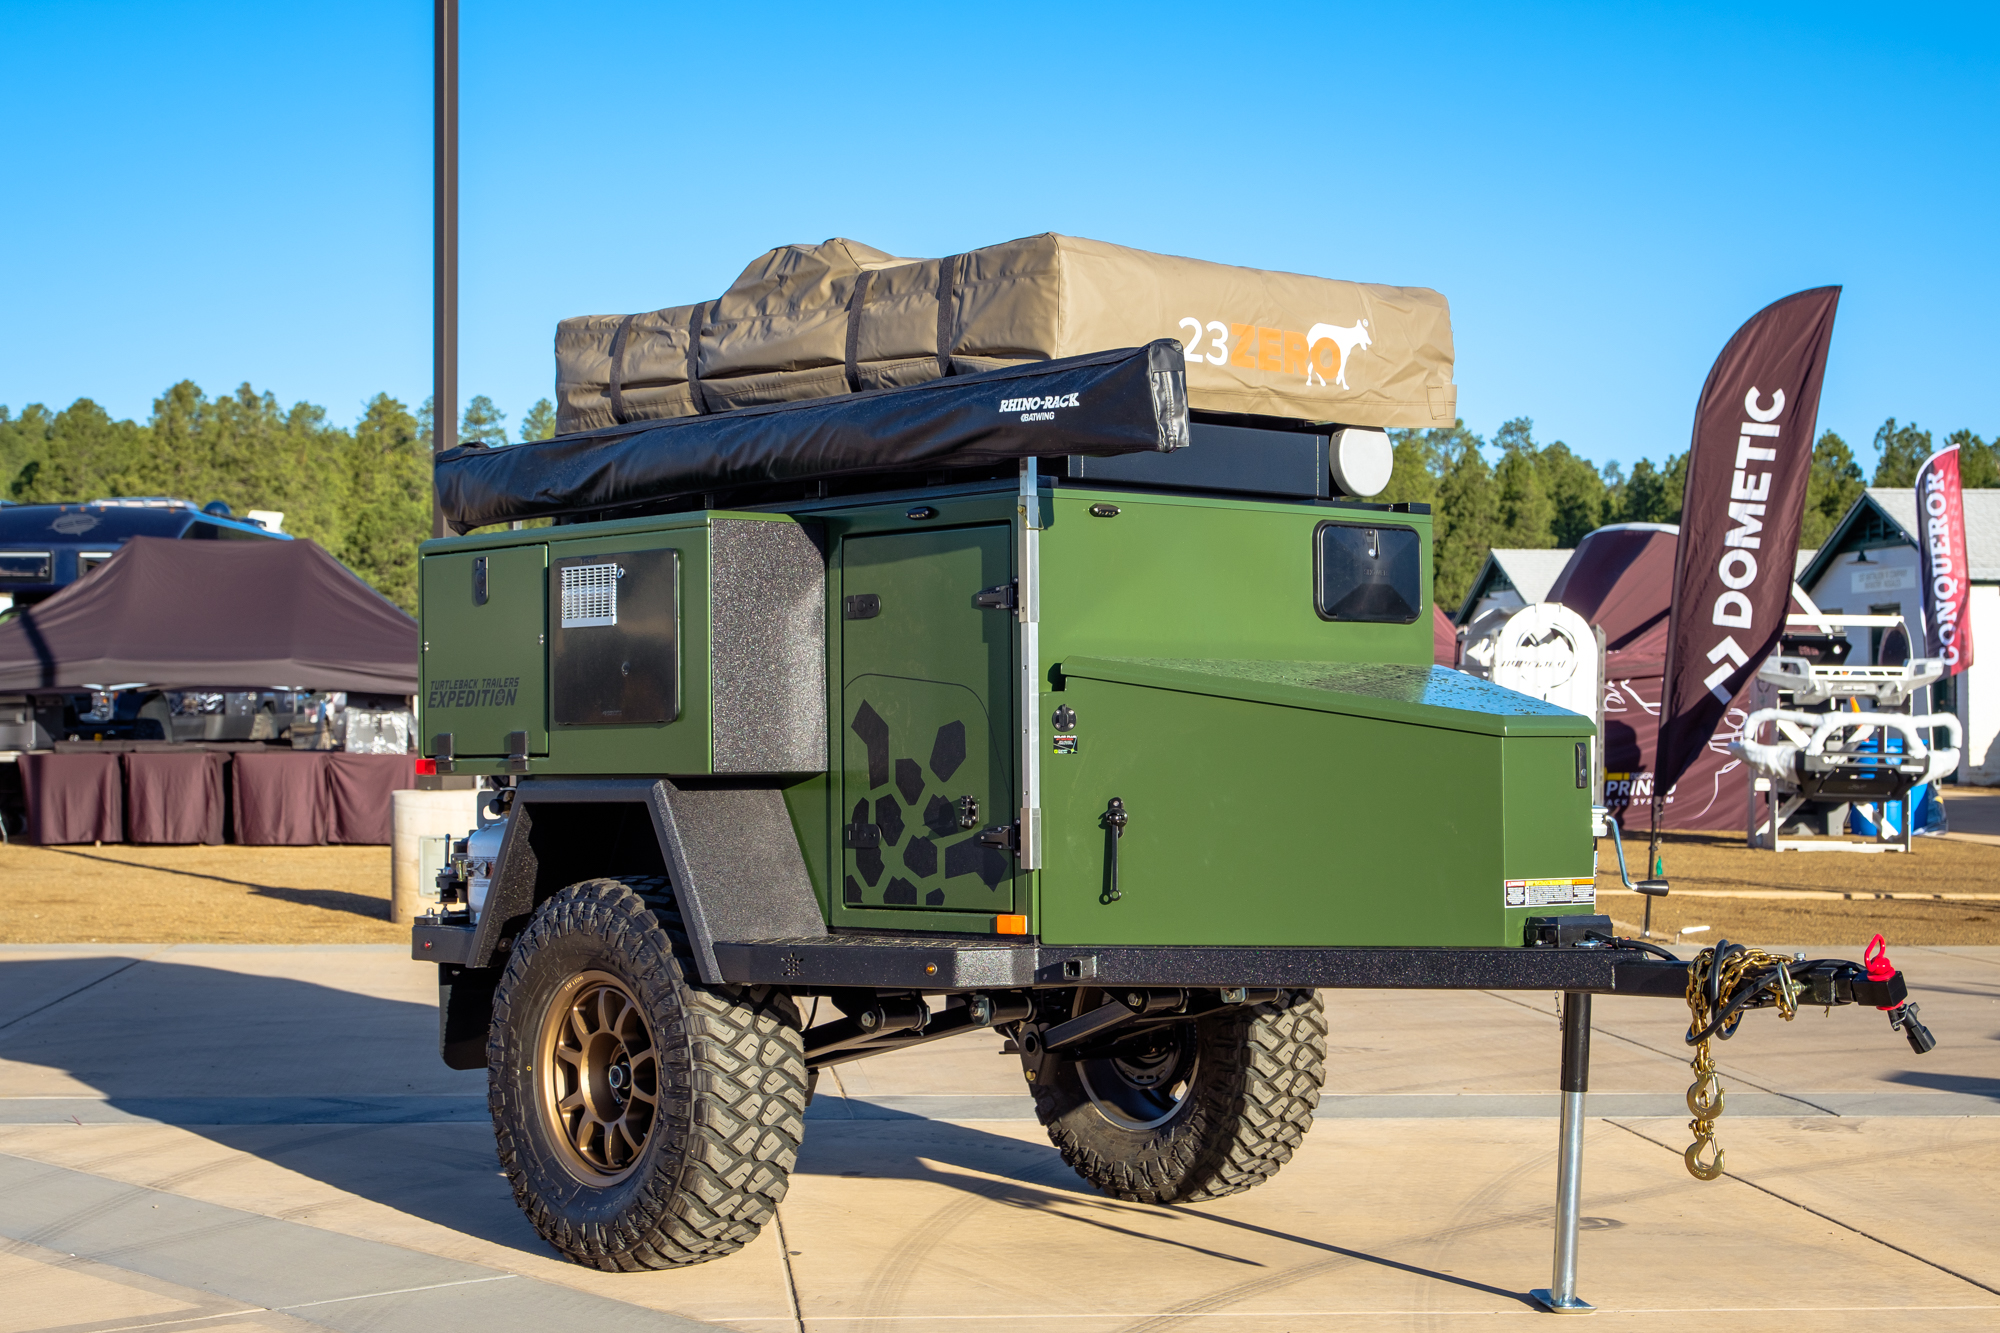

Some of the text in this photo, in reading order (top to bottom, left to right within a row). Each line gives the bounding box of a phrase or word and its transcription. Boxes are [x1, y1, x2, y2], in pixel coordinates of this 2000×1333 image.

[1178, 316, 1342, 380] 23ZERO
[998, 392, 1080, 413] RHINO-RACK
[1711, 385, 1786, 630] DOMETIC
[1926, 469, 1960, 667] CONQUEROR
[430, 677, 520, 690] TURTLEBACK TRAILERS
[427, 688, 518, 709] EXPEDITION
[1606, 798, 1629, 807] ACK
